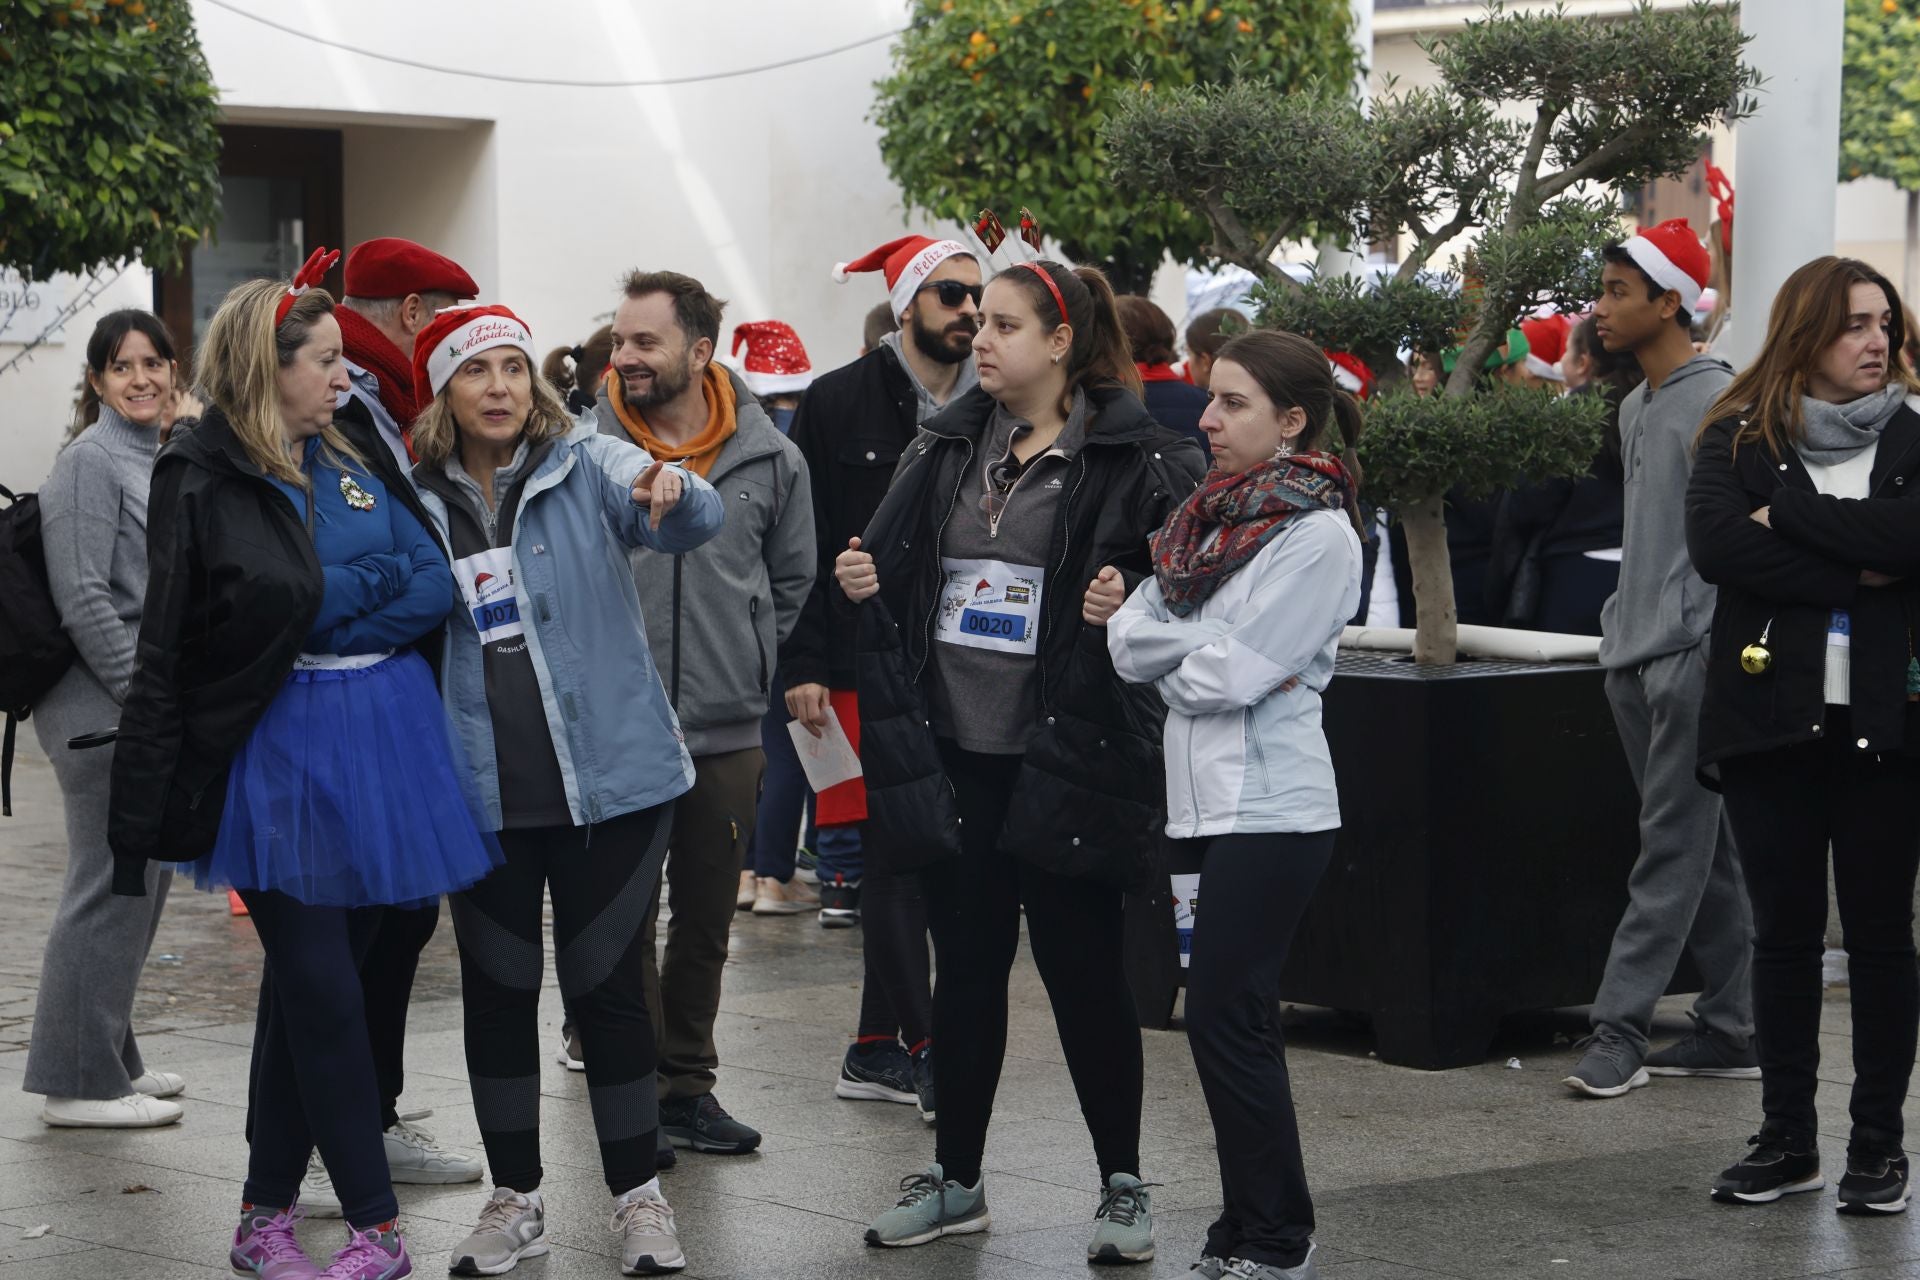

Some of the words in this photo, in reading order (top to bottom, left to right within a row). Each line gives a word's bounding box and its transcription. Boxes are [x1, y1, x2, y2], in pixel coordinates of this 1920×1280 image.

[913, 250, 943, 277] Feliz
[469, 322, 512, 337] Feliz
[461, 330, 516, 352] Navidad
[968, 614, 1013, 635] 0020
